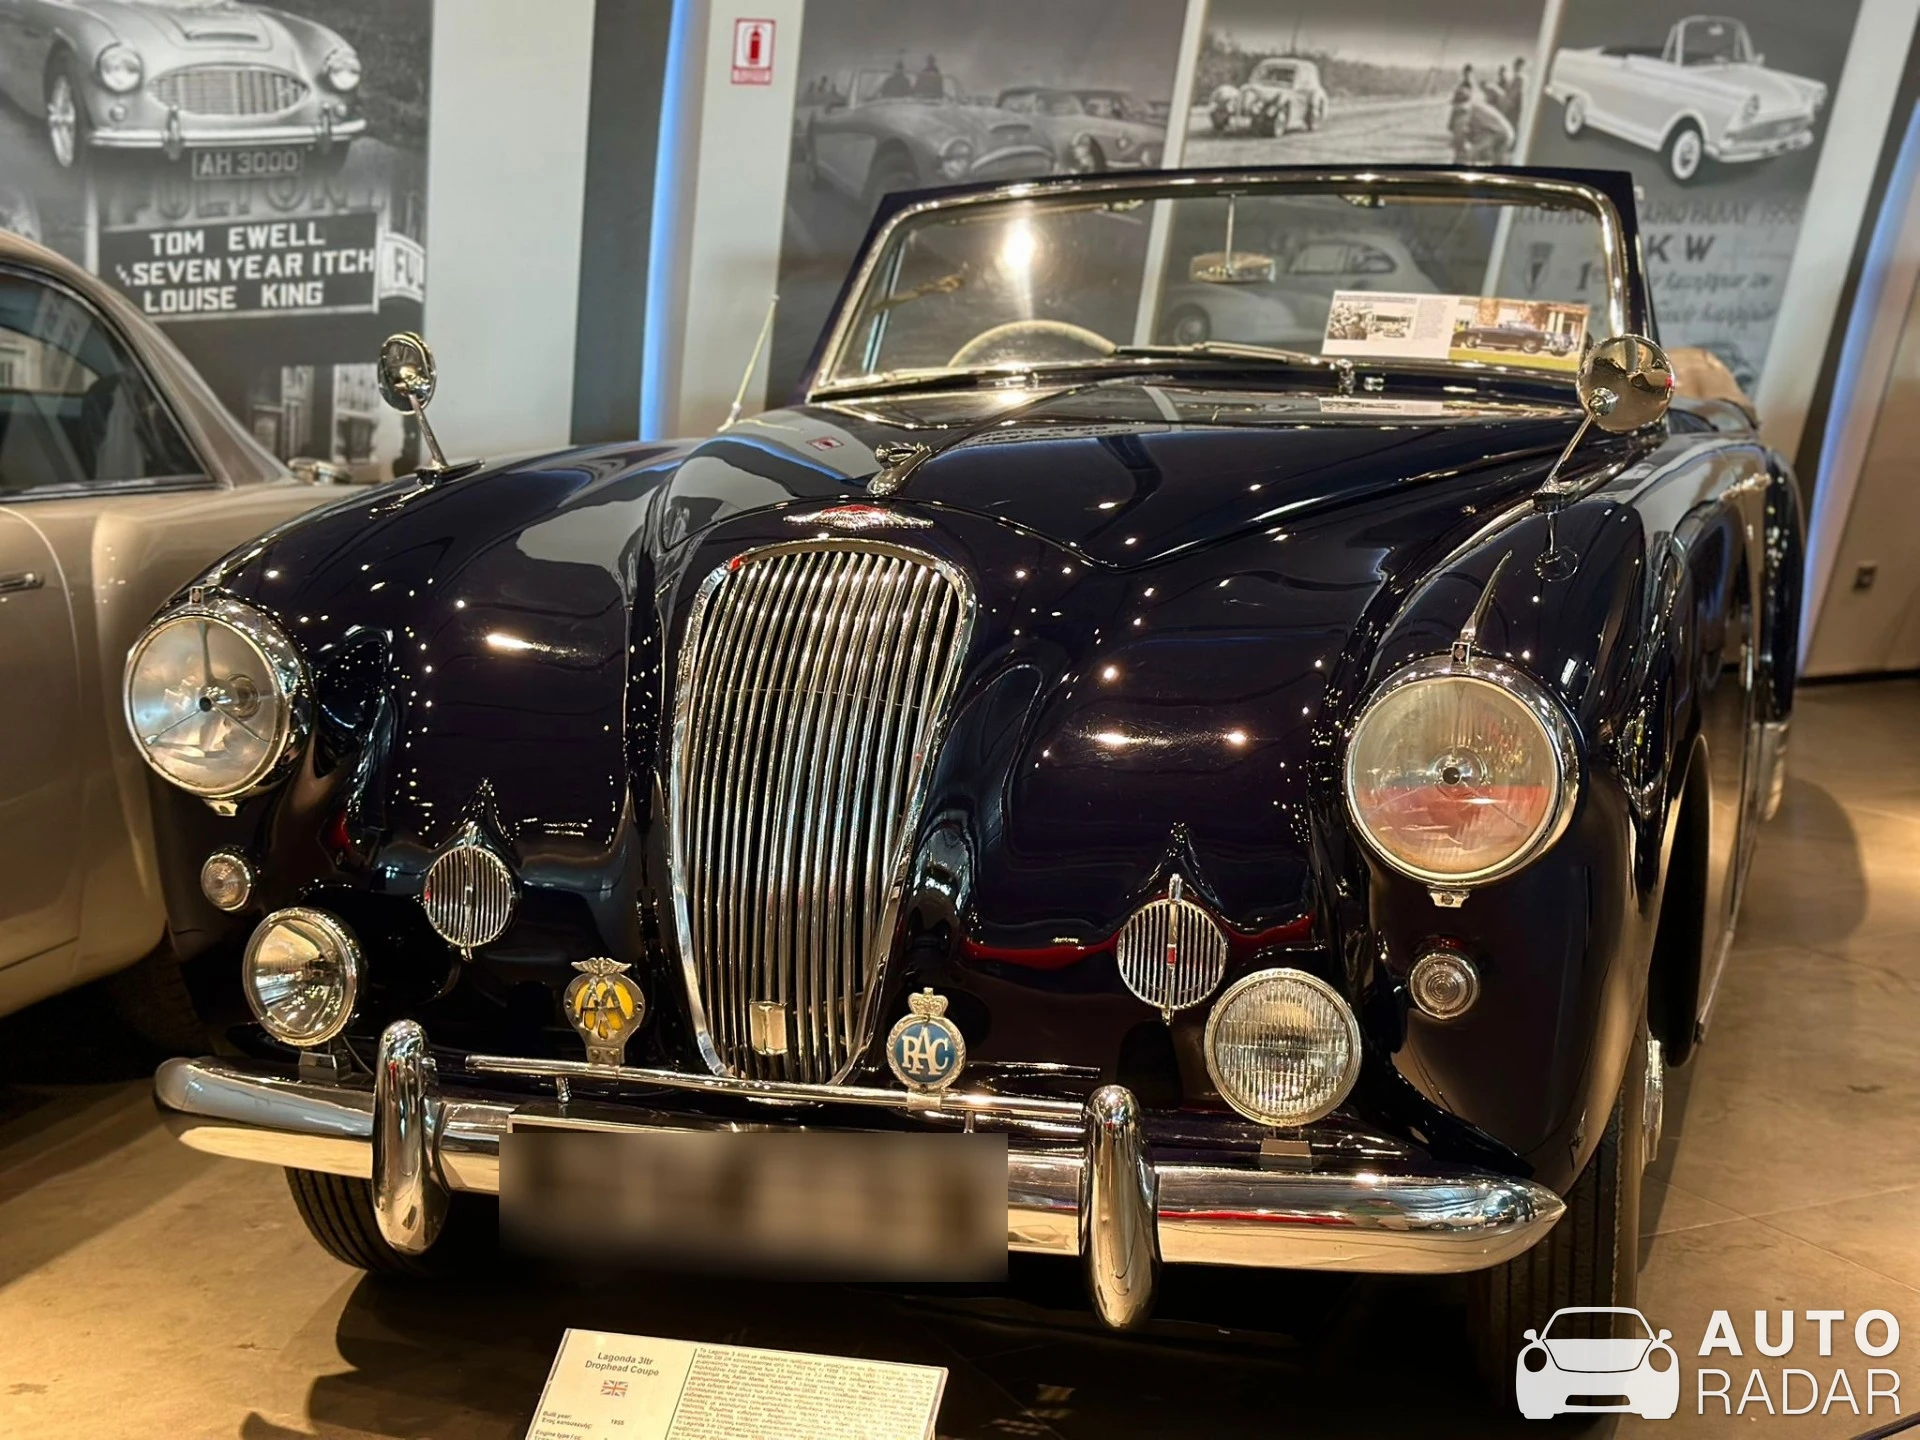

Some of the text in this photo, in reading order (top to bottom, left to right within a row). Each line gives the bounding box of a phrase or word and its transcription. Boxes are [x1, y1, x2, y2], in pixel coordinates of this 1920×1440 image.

[200, 151, 298, 175] AH 3000
[150, 221, 326, 257] TOM EWELL
[132, 248, 374, 286] SEVEN YEAR ITCH
[143, 281, 324, 314] LOUISE KING
[901, 1025, 949, 1075] RAC
[584, 1360, 629, 1372] Drophead
[597, 1352, 637, 1364] Lagonda
